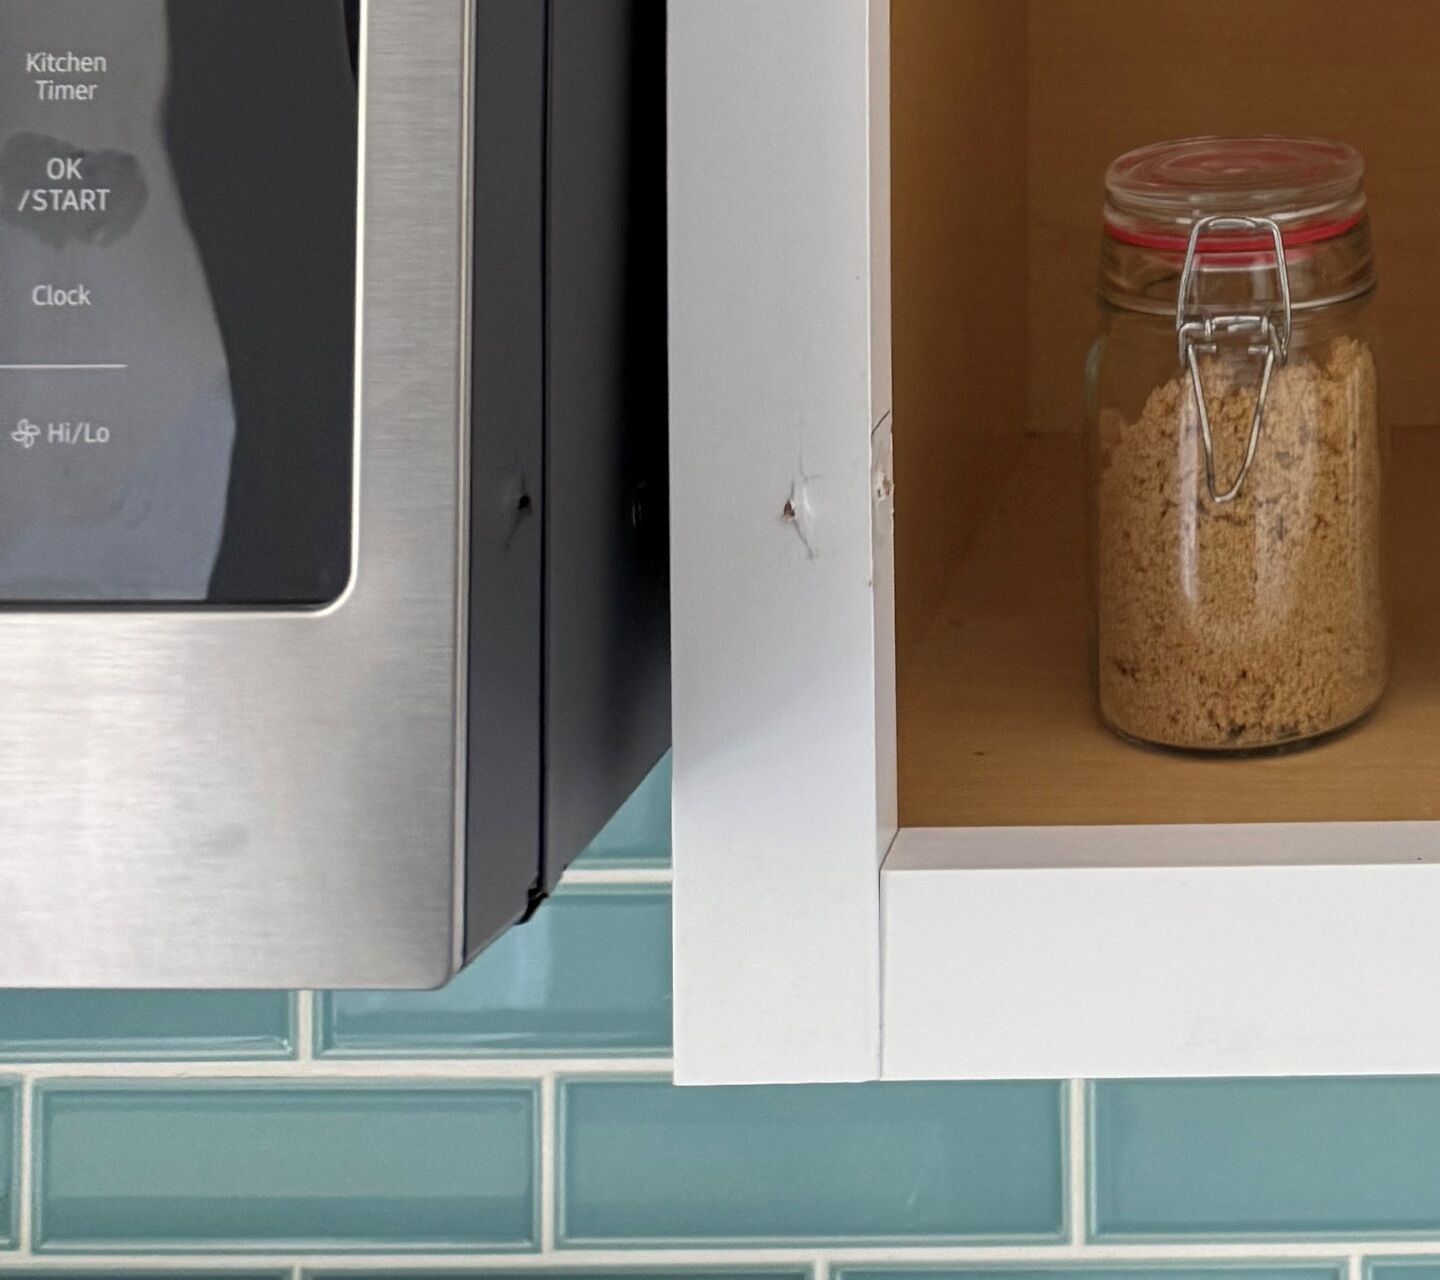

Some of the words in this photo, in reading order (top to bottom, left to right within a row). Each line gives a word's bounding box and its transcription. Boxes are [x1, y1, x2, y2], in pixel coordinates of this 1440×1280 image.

[26, 51, 107, 72] Kitchen
[35, 79, 98, 100] Timer
[46, 157, 83, 180] OK
[17, 189, 110, 212] /START
[32, 284, 91, 306] Clock
[47, 422, 110, 444] Hi/Lo
